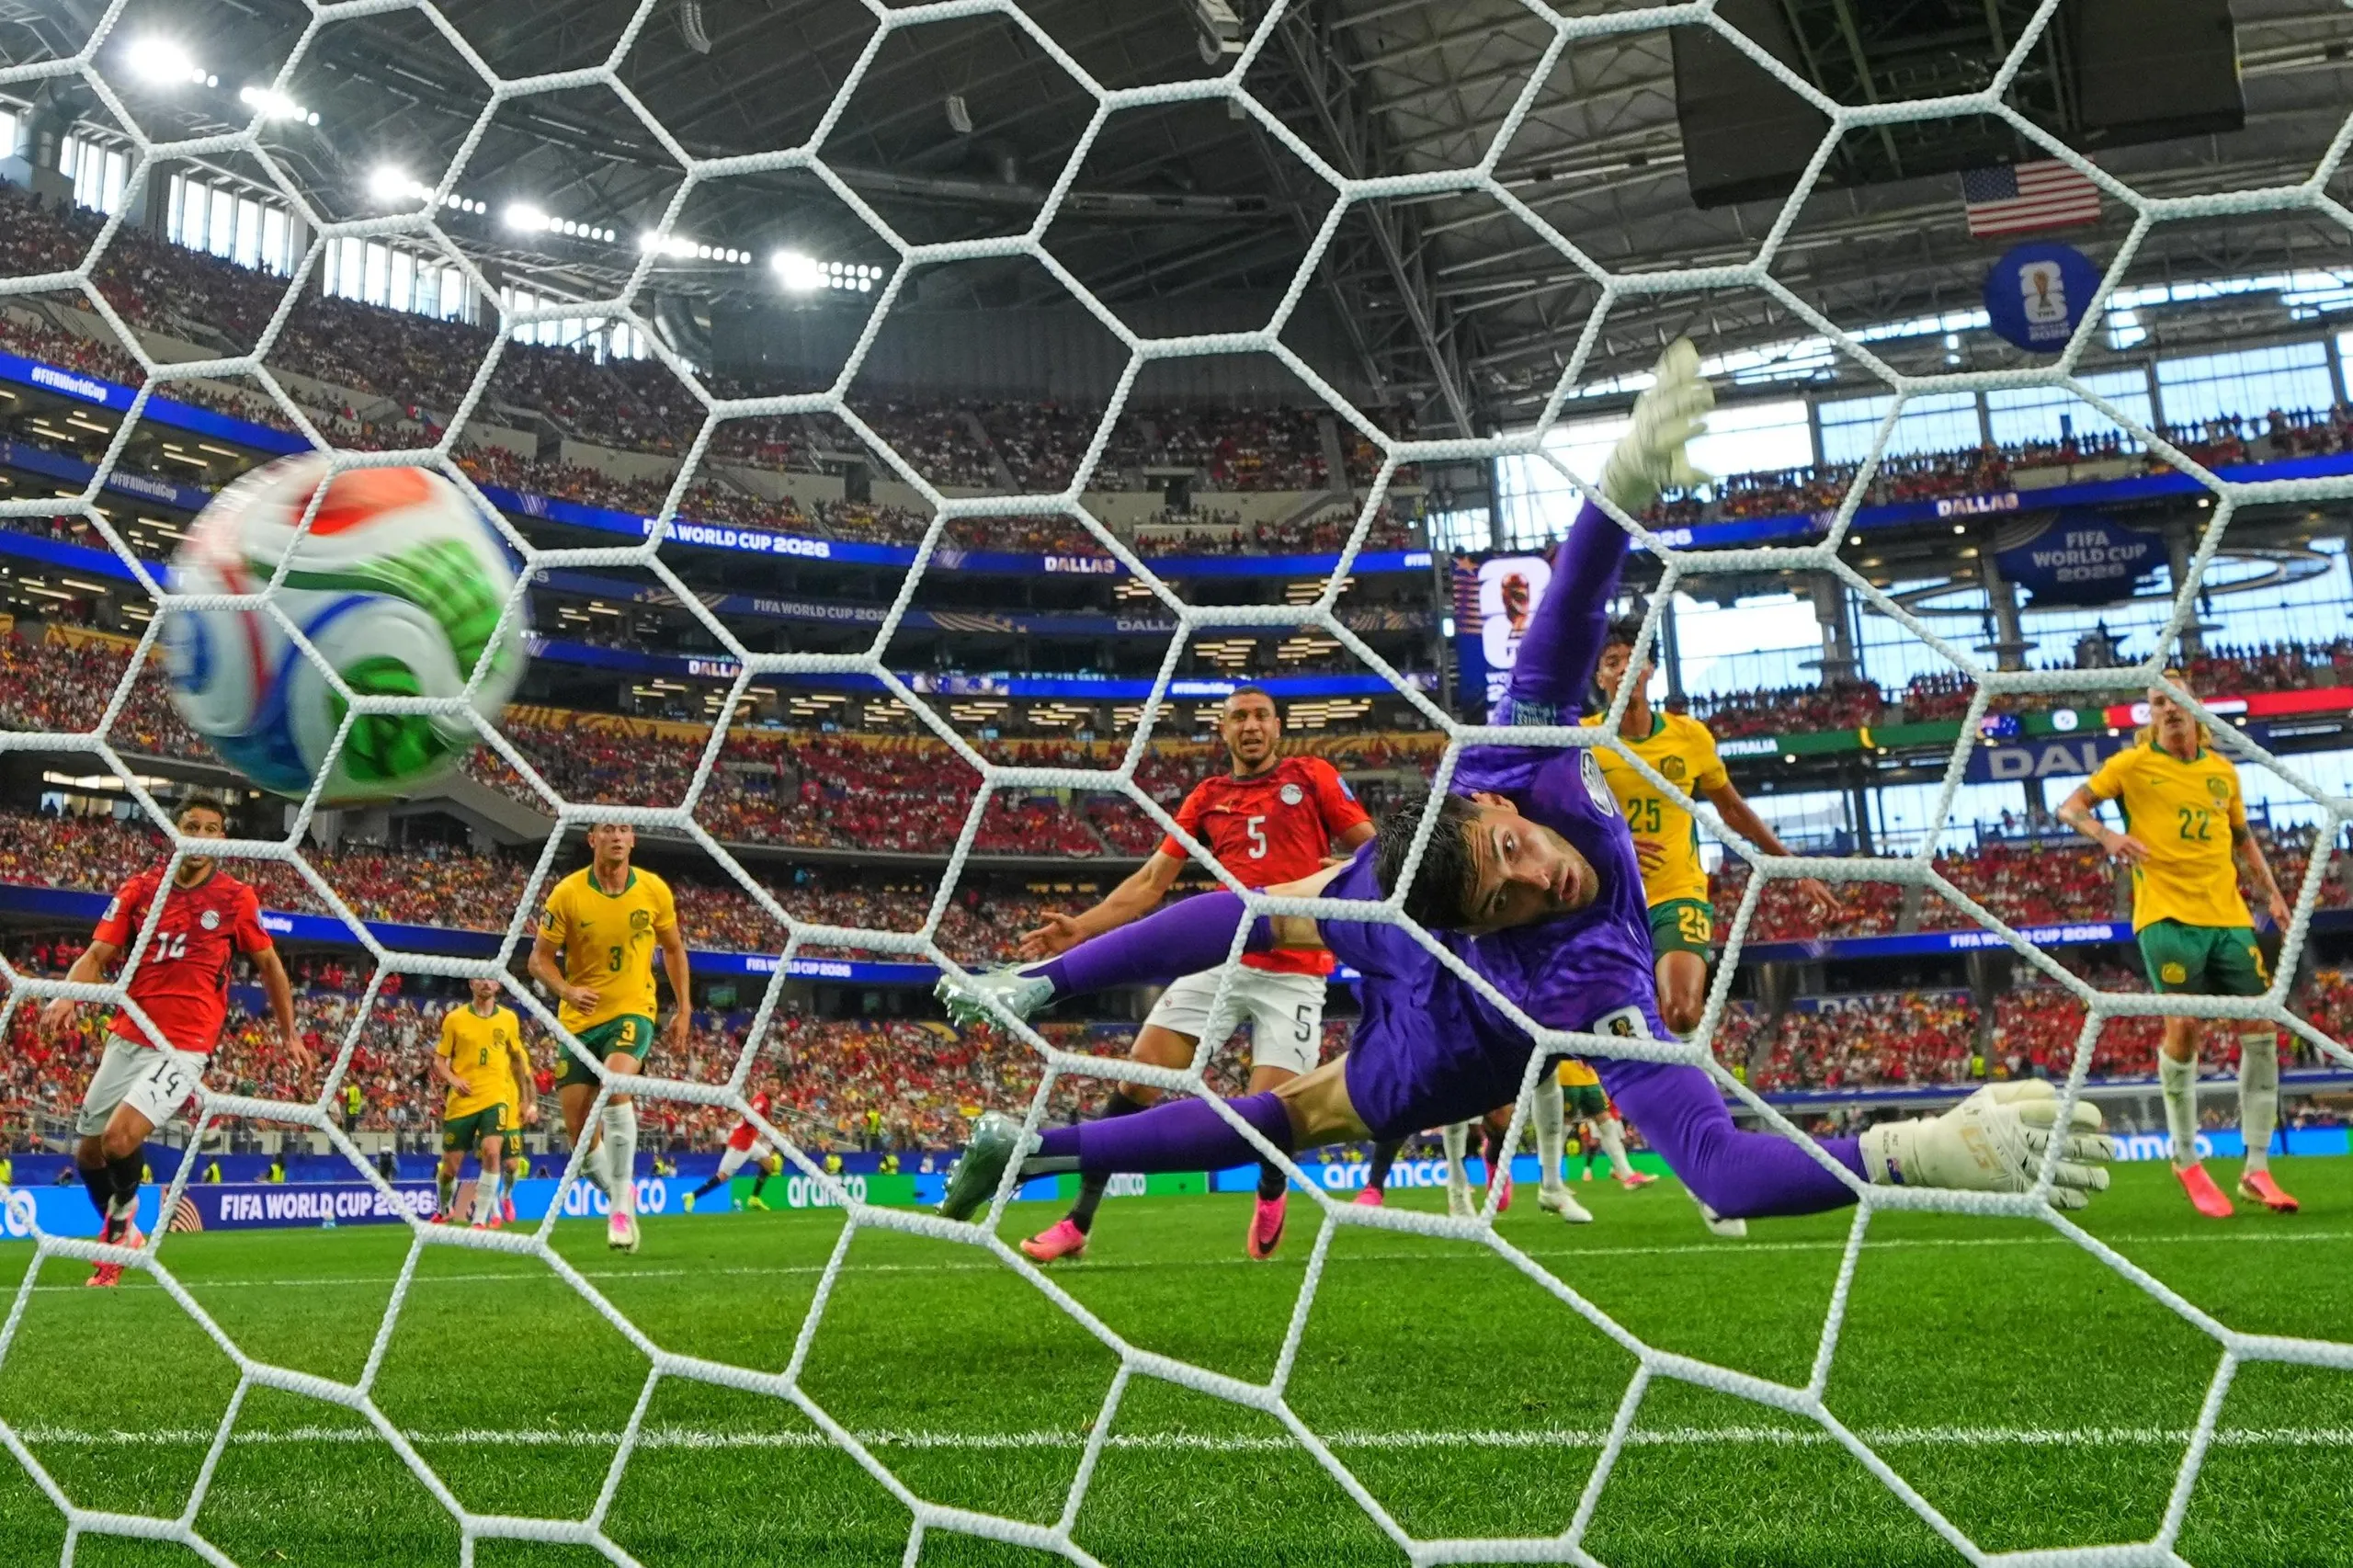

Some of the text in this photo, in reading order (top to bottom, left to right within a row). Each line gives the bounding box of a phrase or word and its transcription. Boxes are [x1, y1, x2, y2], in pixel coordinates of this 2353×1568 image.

[31, 367, 108, 403] #FIFAWorldCup
[110, 472, 177, 502] #FIFAWorldCup
[1937, 493, 2018, 517] DALLAS
[676, 524, 736, 547] WORLD
[738, 532, 772, 551] CUP
[773, 537, 831, 558] 2026
[2066, 530, 2110, 548] FIFA
[1044, 556, 1116, 574] DALLAS
[2032, 543, 2148, 567] WORLD CUP
[2056, 562, 2125, 582] 2026
[754, 599, 889, 621] FIFA WORLD CUP 202
[1116, 619, 1183, 631] DALL
[688, 660, 741, 677] DALLA
[1717, 738, 1779, 756] USTRALIA
[1628, 798, 1661, 834] 25
[2178, 808, 2212, 841] 22
[1247, 815, 1267, 859] 5
[1677, 905, 1711, 942] 25
[1949, 933, 1982, 948] FIFA
[2032, 927, 2061, 943] CUP
[2062, 925, 2112, 941] 2026
[609, 946, 622, 972] 3
[801, 961, 820, 974] CUP
[621, 1020, 636, 1042] 3
[1294, 1004, 1311, 1043] 5
[480, 1048, 487, 1065] 8
[220, 1194, 263, 1221] FIFA
[266, 1193, 335, 1220] WORLD
[335, 1192, 372, 1218] CUP
